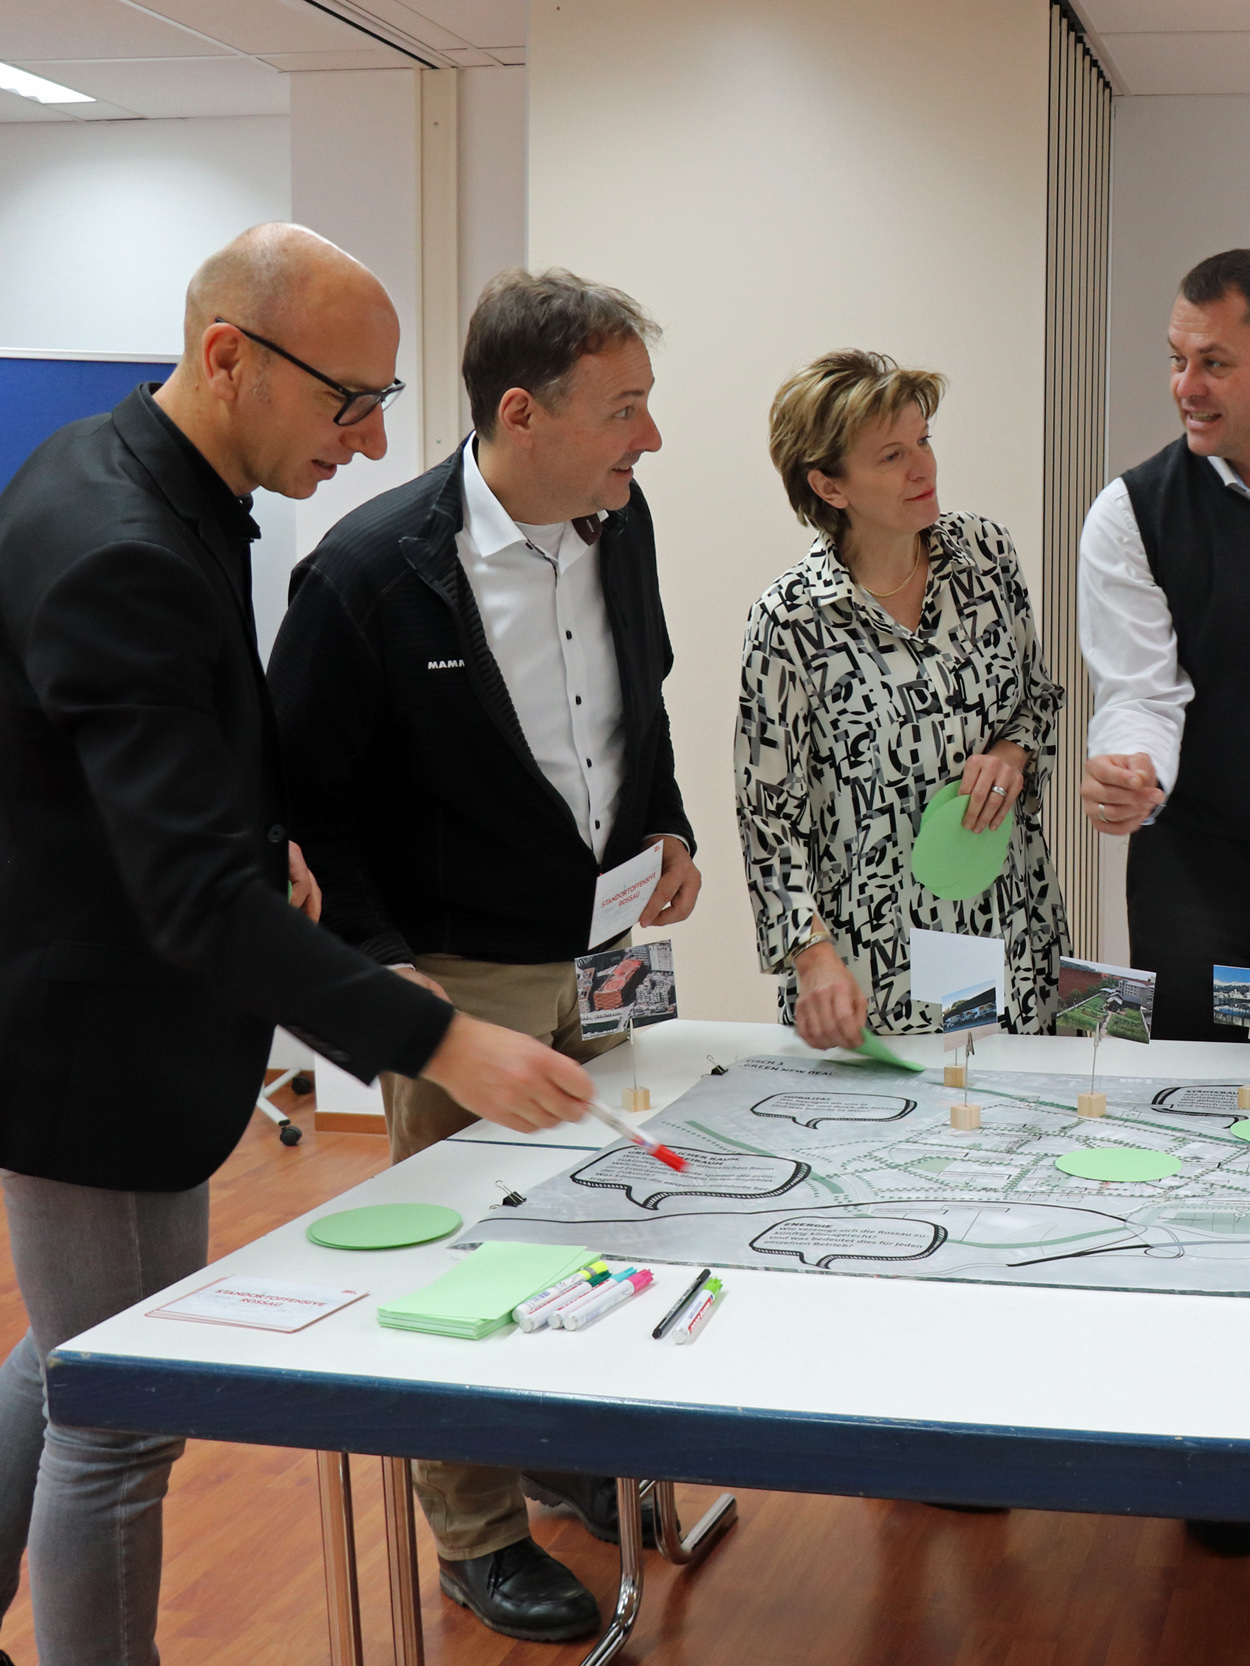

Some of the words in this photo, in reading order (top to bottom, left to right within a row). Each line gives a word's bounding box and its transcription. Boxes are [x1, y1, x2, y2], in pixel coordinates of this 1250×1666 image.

[601, 872, 656, 908] STANDORTOFFENSIVE
[618, 891, 640, 907] ROSSAU
[215, 1288, 327, 1307] STANDORTOFFENSIVE
[241, 1297, 283, 1306] ROSSAU
